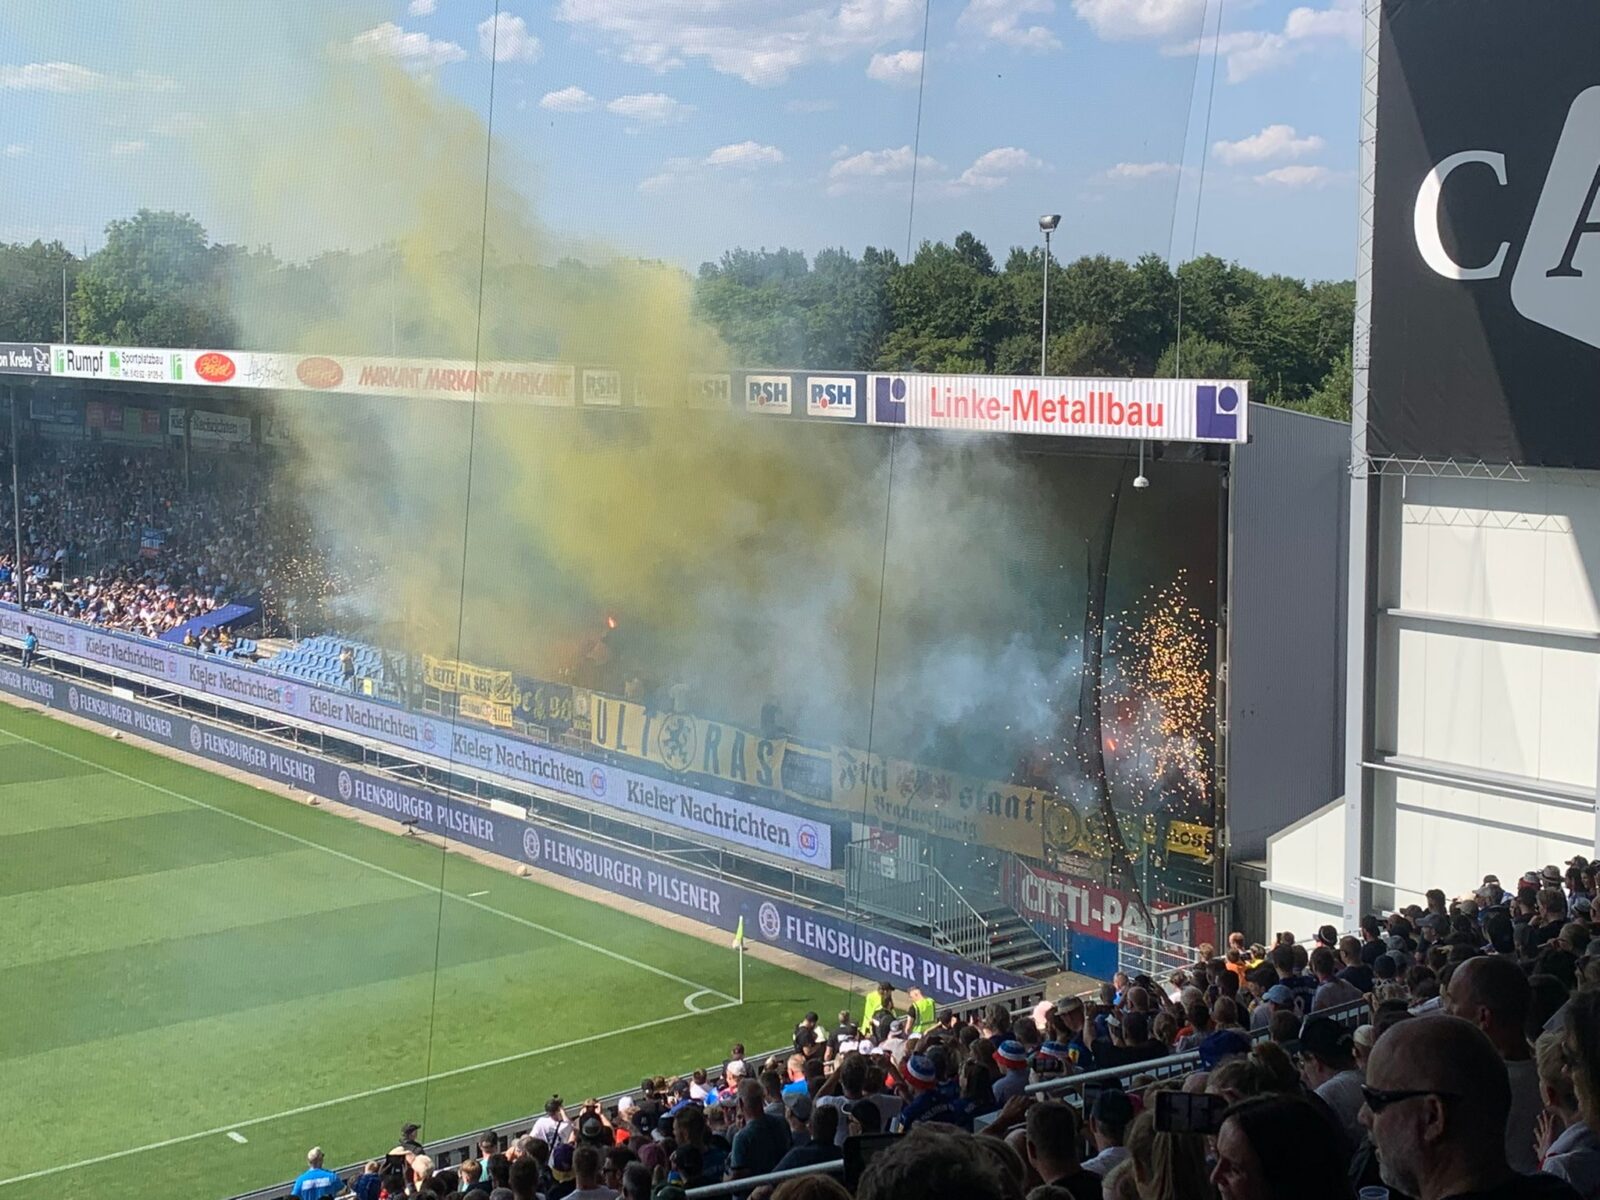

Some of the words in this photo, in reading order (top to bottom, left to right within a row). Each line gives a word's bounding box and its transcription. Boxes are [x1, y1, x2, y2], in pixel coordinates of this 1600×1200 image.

[9, 349, 33, 368] Krebs
[67, 350, 103, 376] Rumpf
[121, 351, 164, 366] Sportplatzbau
[358, 365, 424, 388] MARKANT
[425, 366, 495, 393] MARKANT
[749, 382, 787, 402] RSH
[811, 384, 852, 405] RSH
[930, 386, 1164, 428] Linke-Metallbau
[20, 619, 65, 645] Nhrichten
[86, 636, 110, 657] Kieler
[111, 643, 165, 673] Nachrichten
[22, 675, 54, 700] PILSENER
[189, 663, 217, 687] Kieler
[218, 673, 281, 703] Nachrichten
[80, 694, 134, 727] FLENSBURGER
[134, 713, 173, 739] PILSENER
[308, 694, 343, 721] Kieler
[345, 705, 418, 741] Nachrichten
[203, 732, 268, 769] FLENSBURGER
[269, 752, 316, 784] PILSENER
[452, 731, 493, 762] Kieler
[495, 744, 585, 788] Nachrichten
[354, 780, 433, 822] FLENSBURGER
[436, 804, 494, 842] PILSENER
[627, 779, 677, 813] Kieler
[679, 795, 790, 847] Nachrichten
[543, 838, 643, 890] FLENSBURGER
[647, 870, 721, 916] PILSENER
[786, 914, 915, 981] FLENSBURGER
[922, 959, 1012, 1002] PILSEN
